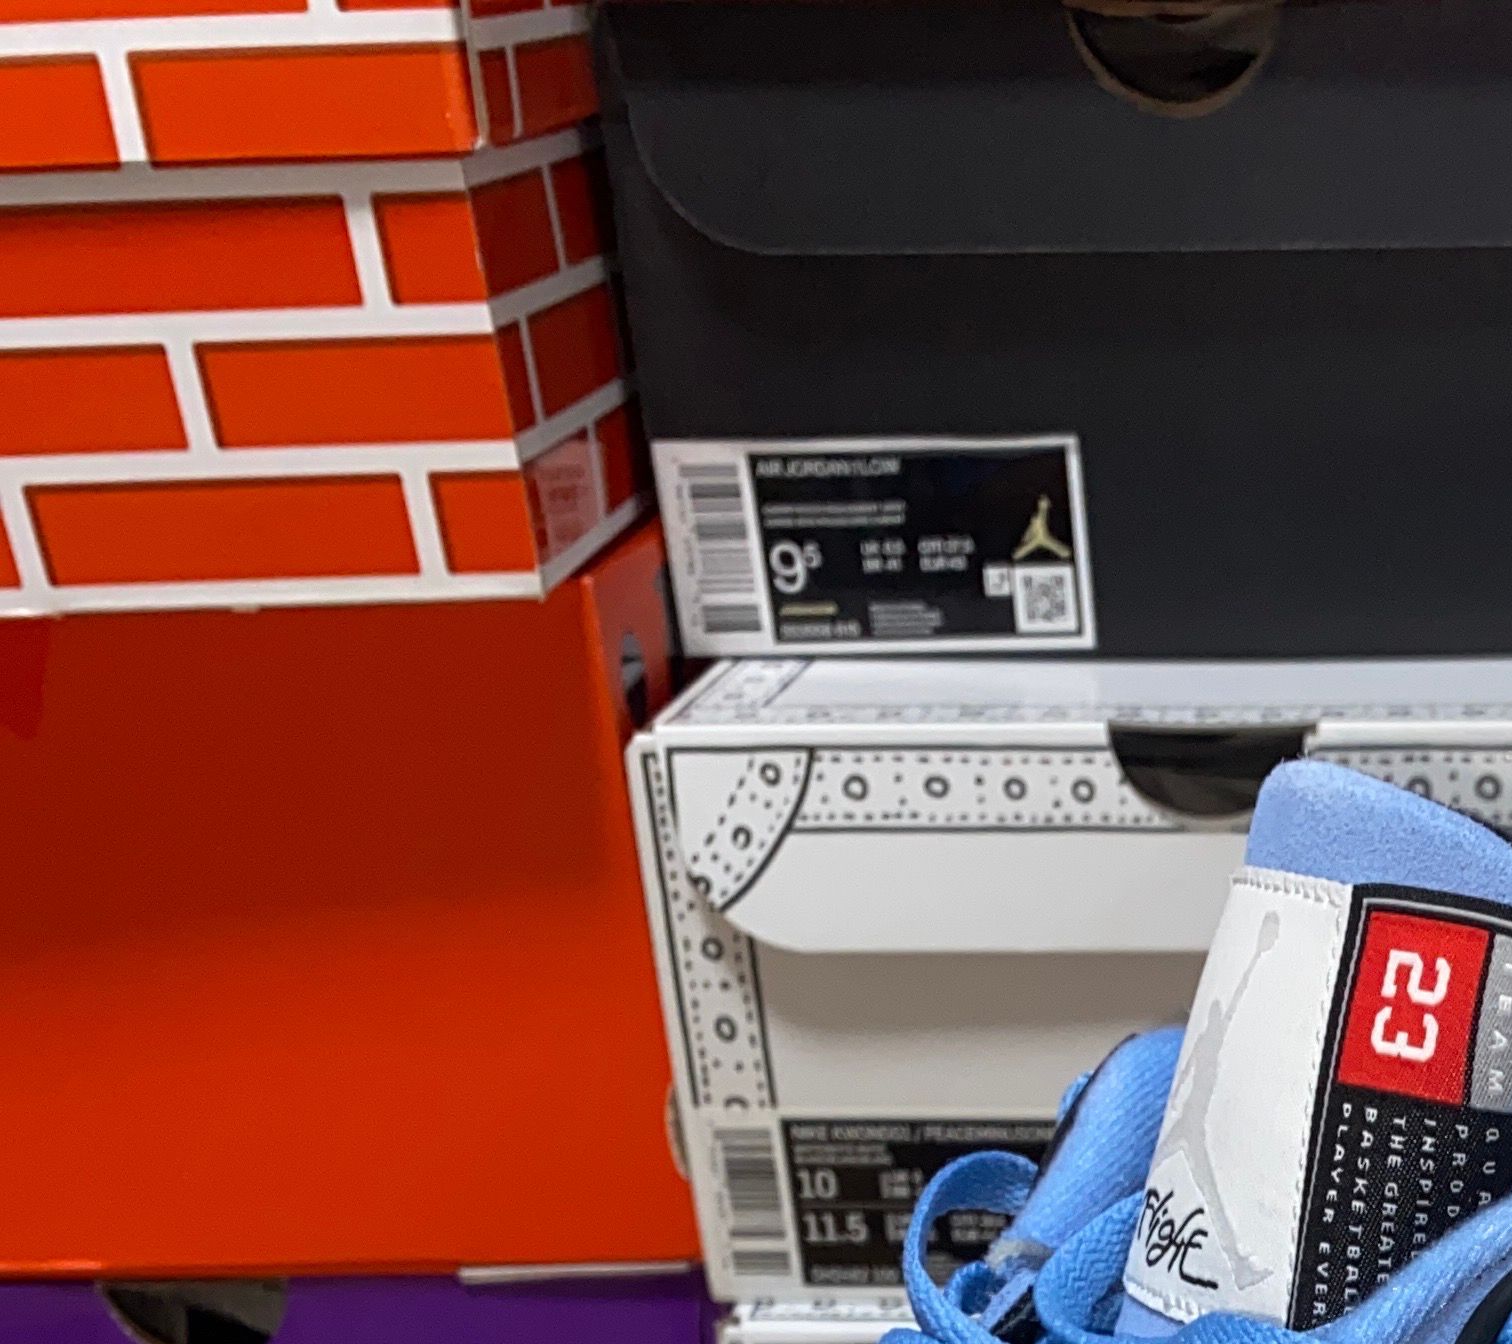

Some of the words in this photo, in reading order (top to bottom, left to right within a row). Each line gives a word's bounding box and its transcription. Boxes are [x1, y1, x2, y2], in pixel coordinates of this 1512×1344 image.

[1370, 948, 1451, 1063] 23
[1322, 1102, 1352, 1223] PLAYER
[1387, 1116, 1407, 1168] THE
[797, 1167, 840, 1200] 10
[801, 1210, 868, 1243] 11.5
[1376, 1181, 1399, 1284] GREATE
